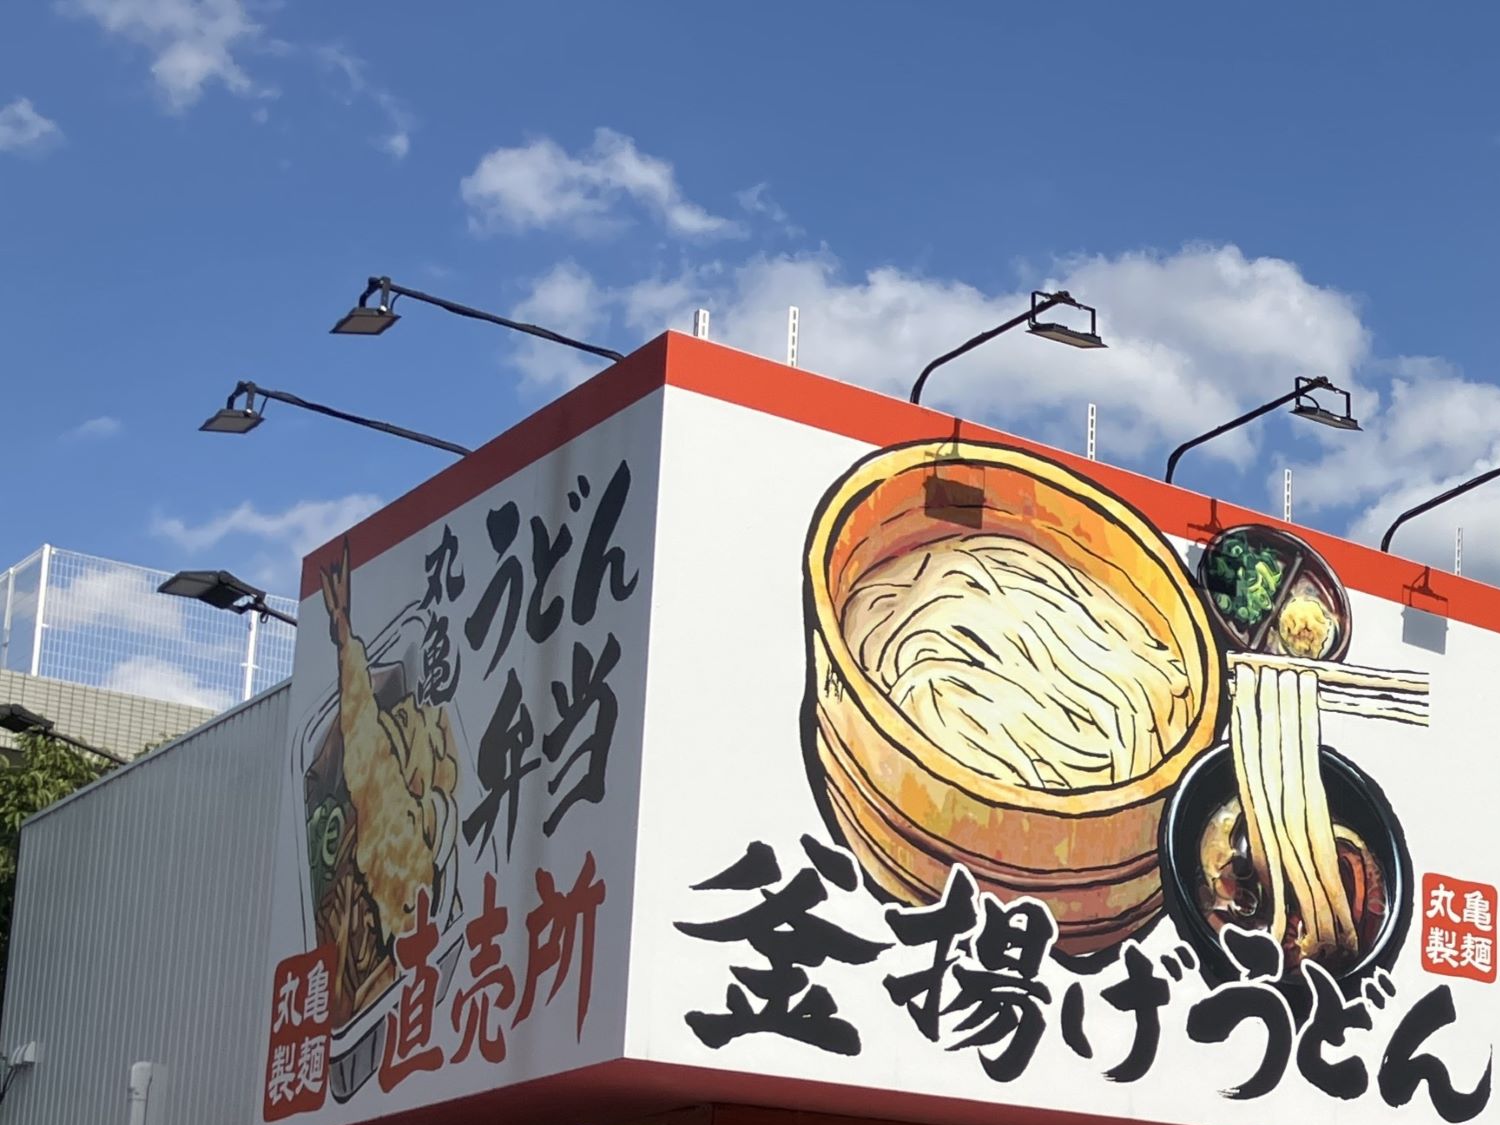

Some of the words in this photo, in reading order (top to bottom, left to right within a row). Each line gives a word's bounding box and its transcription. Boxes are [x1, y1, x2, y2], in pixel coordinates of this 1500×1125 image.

[416, 524, 466, 707] 丸亀
[464, 459, 640, 680] うどん
[462, 632, 623, 865] 弁当
[272, 957, 330, 1034] 丸亀
[378, 850, 606, 1095] 直売所
[673, 834, 1494, 1124] 釜揚げうどん
[1425, 883, 1493, 931] 丸亀
[1425, 926, 1493, 973] 製麺
[268, 1034, 329, 1106] 製麺
